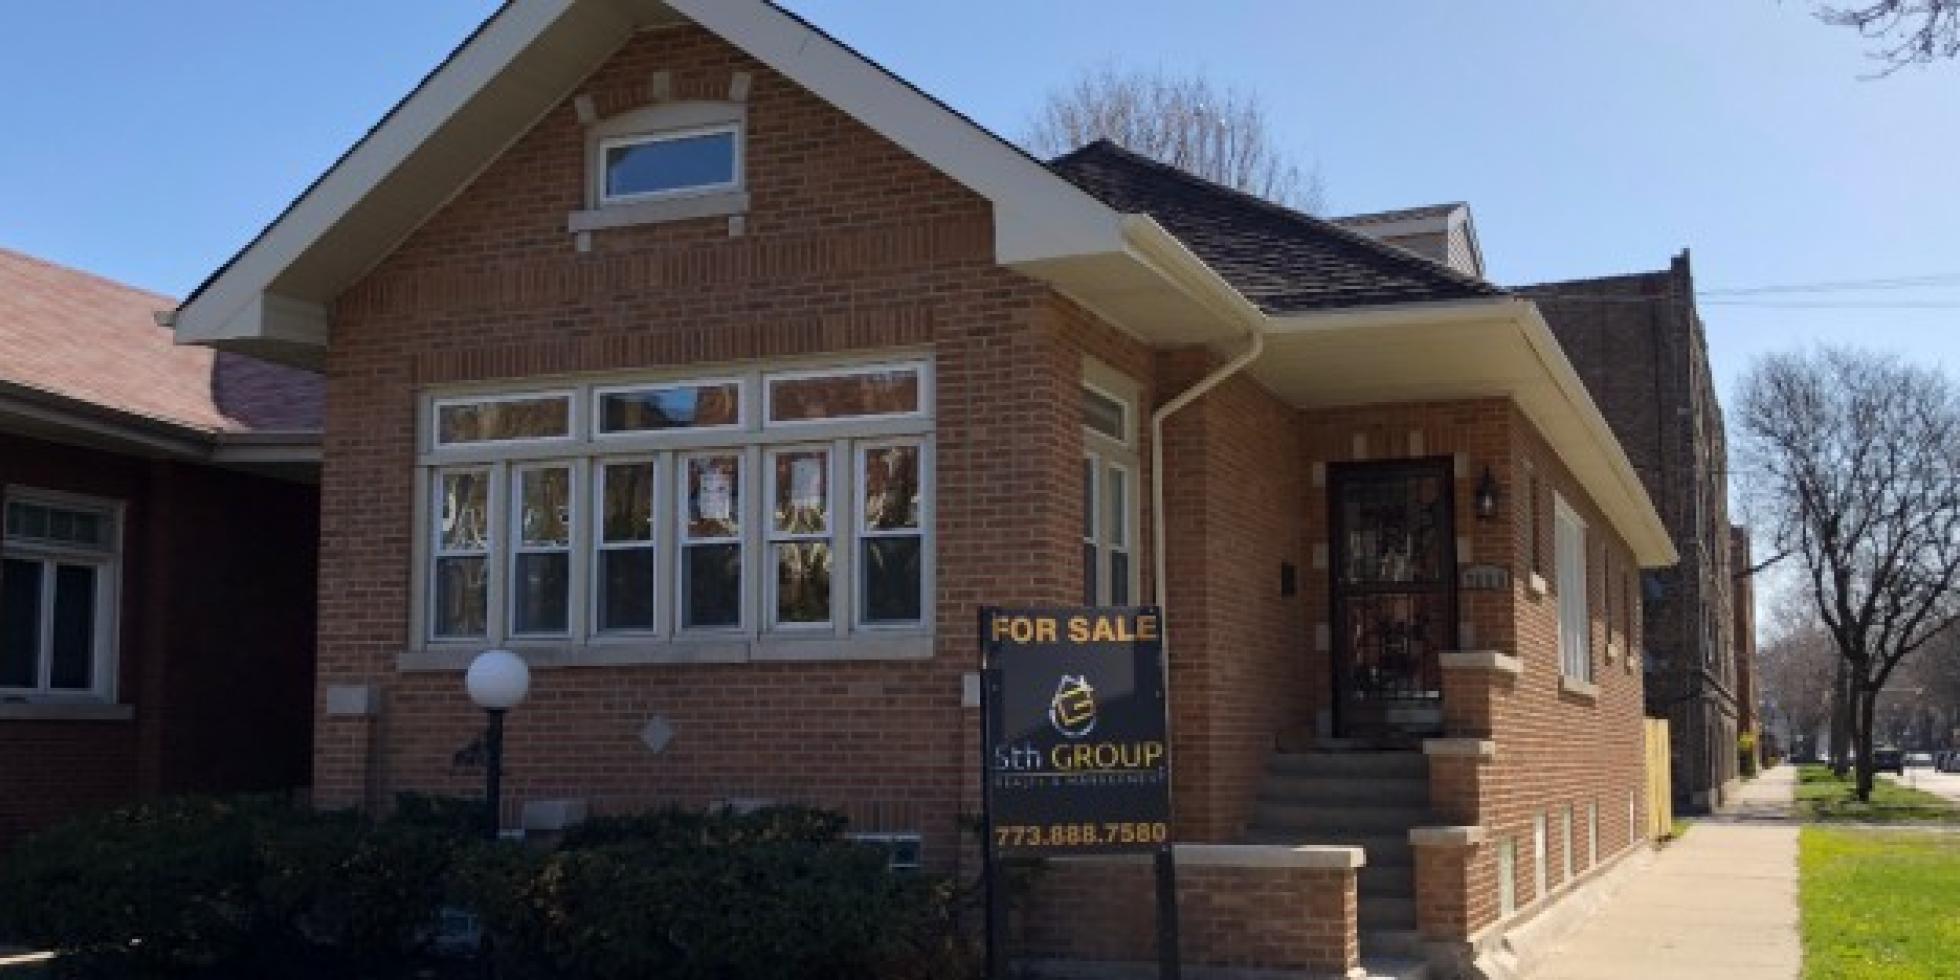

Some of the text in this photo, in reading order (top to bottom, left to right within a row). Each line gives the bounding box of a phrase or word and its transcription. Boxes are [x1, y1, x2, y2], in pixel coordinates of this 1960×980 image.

[991, 615, 1158, 643] FOR SALE
[995, 742, 1163, 770] 5th GROUP
[995, 823, 1167, 846] 773.888.7580
